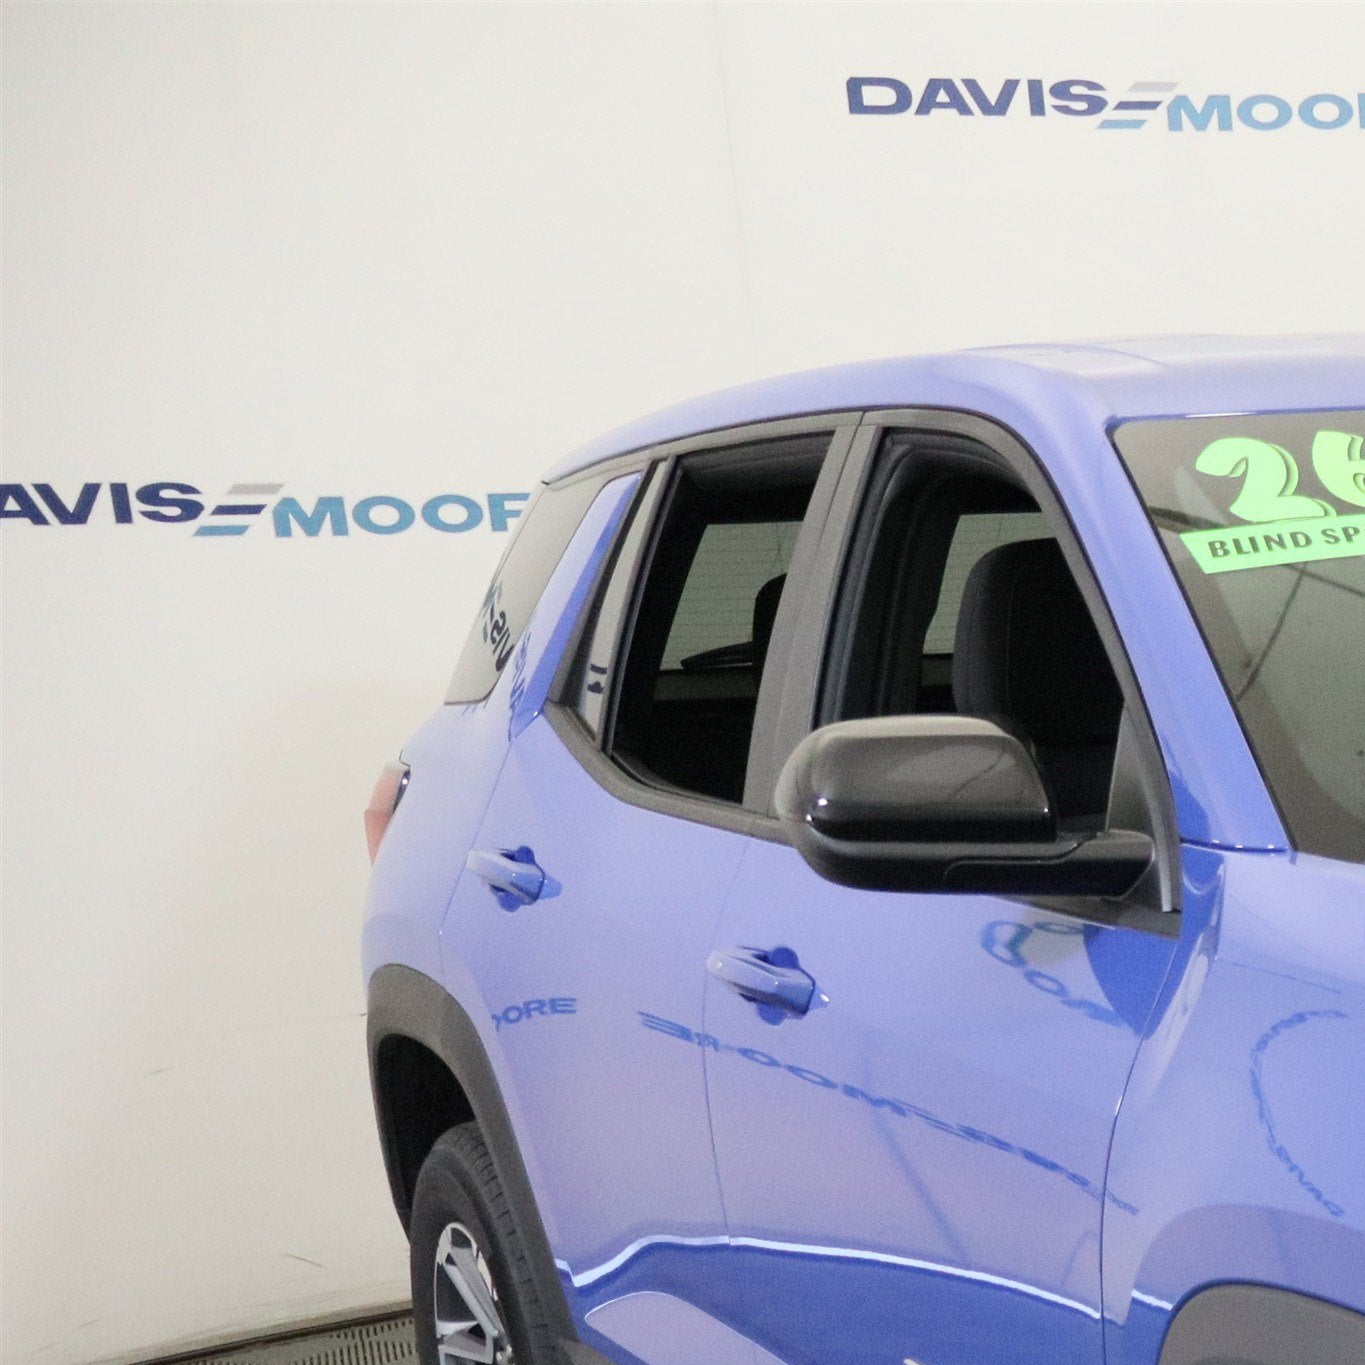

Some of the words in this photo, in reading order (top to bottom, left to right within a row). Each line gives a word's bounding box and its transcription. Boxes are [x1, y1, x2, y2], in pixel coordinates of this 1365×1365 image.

[845, 76, 1109, 117] DAVIS
[0, 481, 206, 526] AVIS
[1208, 530, 1313, 559] BLIND
